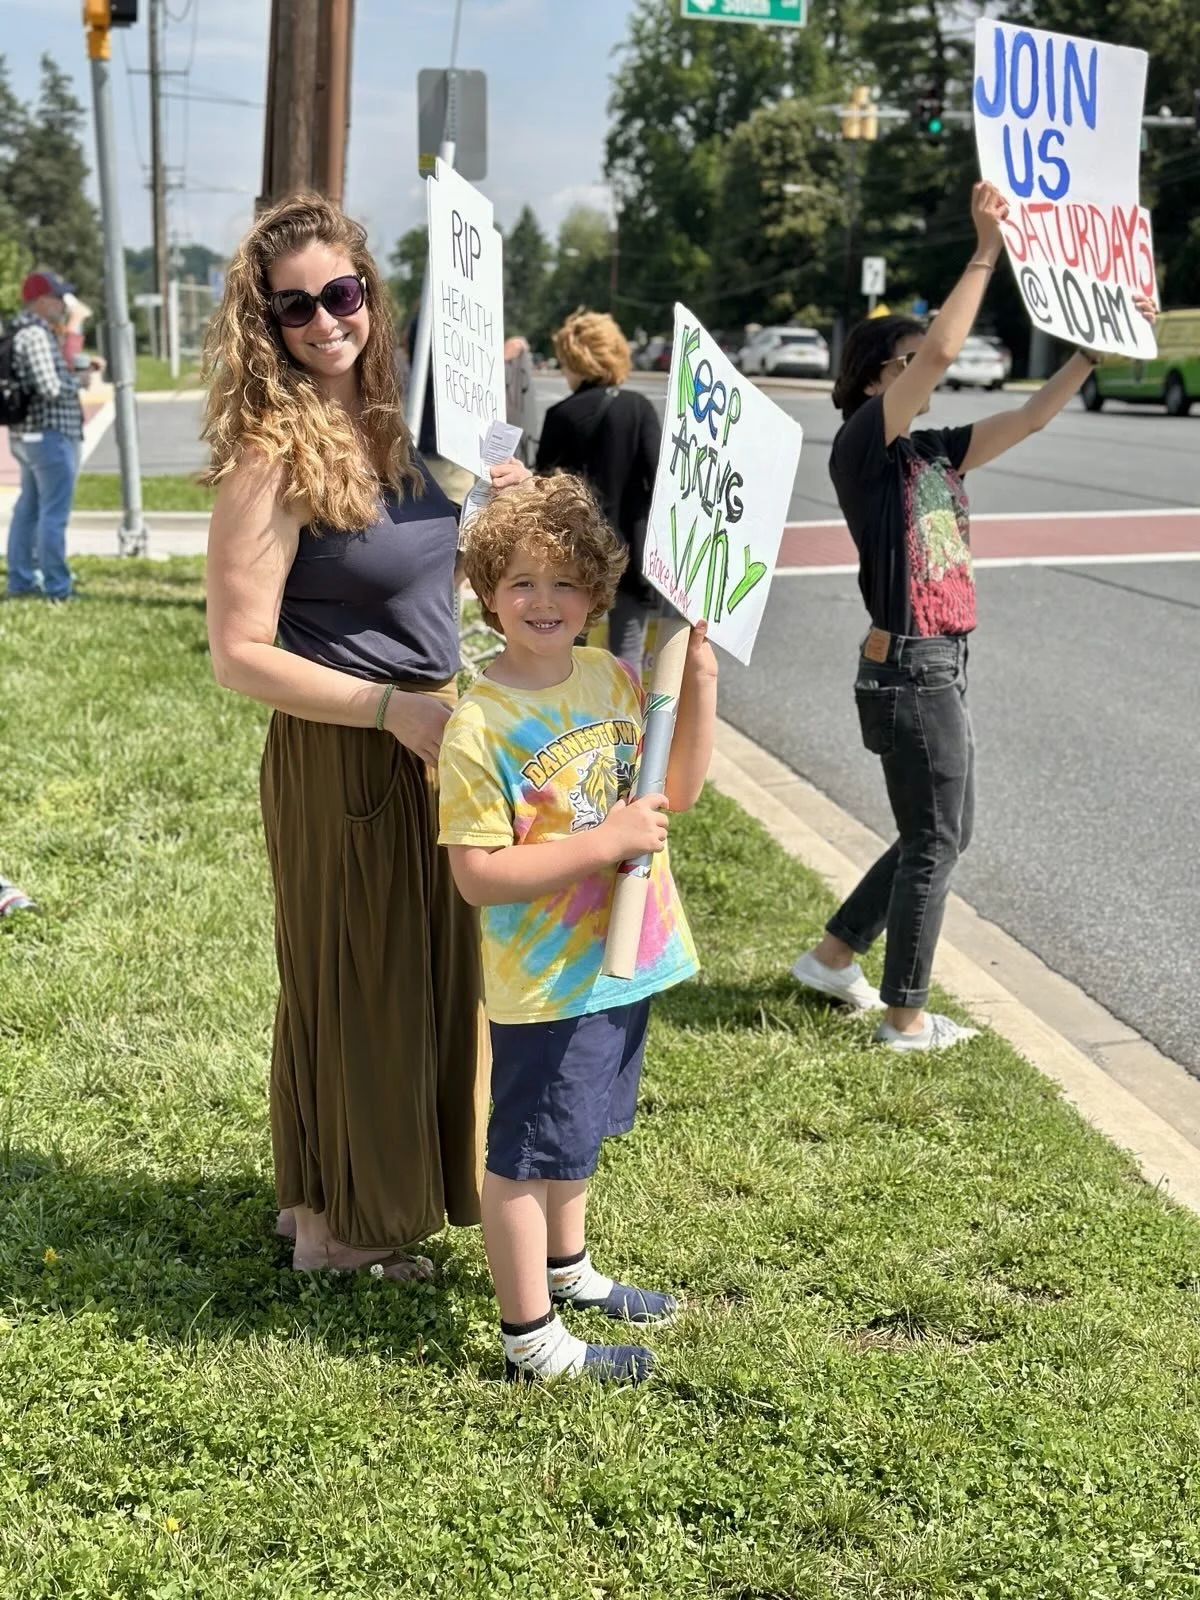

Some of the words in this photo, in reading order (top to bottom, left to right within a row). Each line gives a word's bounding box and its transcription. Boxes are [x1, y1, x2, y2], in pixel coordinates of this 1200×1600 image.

[975, 27, 1098, 131] JOIN
[1003, 123, 1071, 201] US
[451, 209, 481, 281] RIP
[1003, 202, 1154, 297] SATURDAYS
[441, 280, 494, 346] HEALTH
[442, 322, 496, 386] EQUITY
[445, 364, 498, 422] RESEARCH
[677, 324, 741, 448] Keep
[669, 416, 744, 523] ASKING
